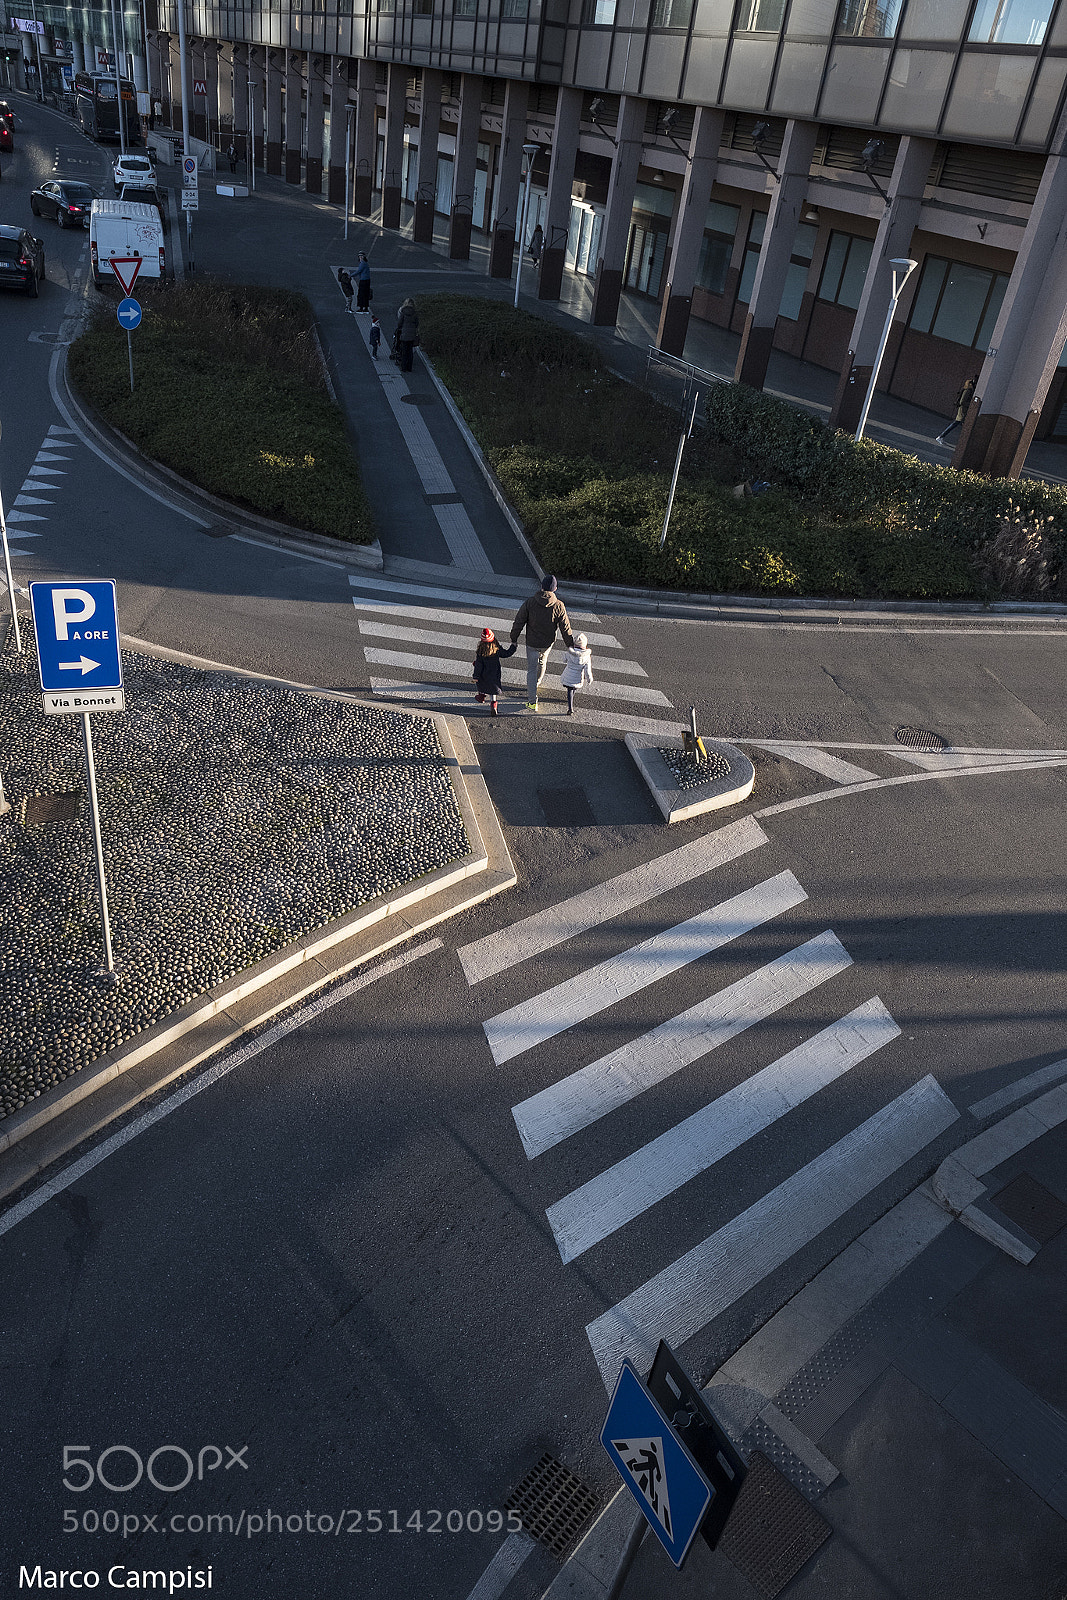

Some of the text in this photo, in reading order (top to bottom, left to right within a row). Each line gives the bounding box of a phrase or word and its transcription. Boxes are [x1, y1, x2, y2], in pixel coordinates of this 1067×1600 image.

[194, 81, 207, 95] M
[51, 588, 109, 641] P A ORE
[51, 696, 117, 708] Via Bonnet
